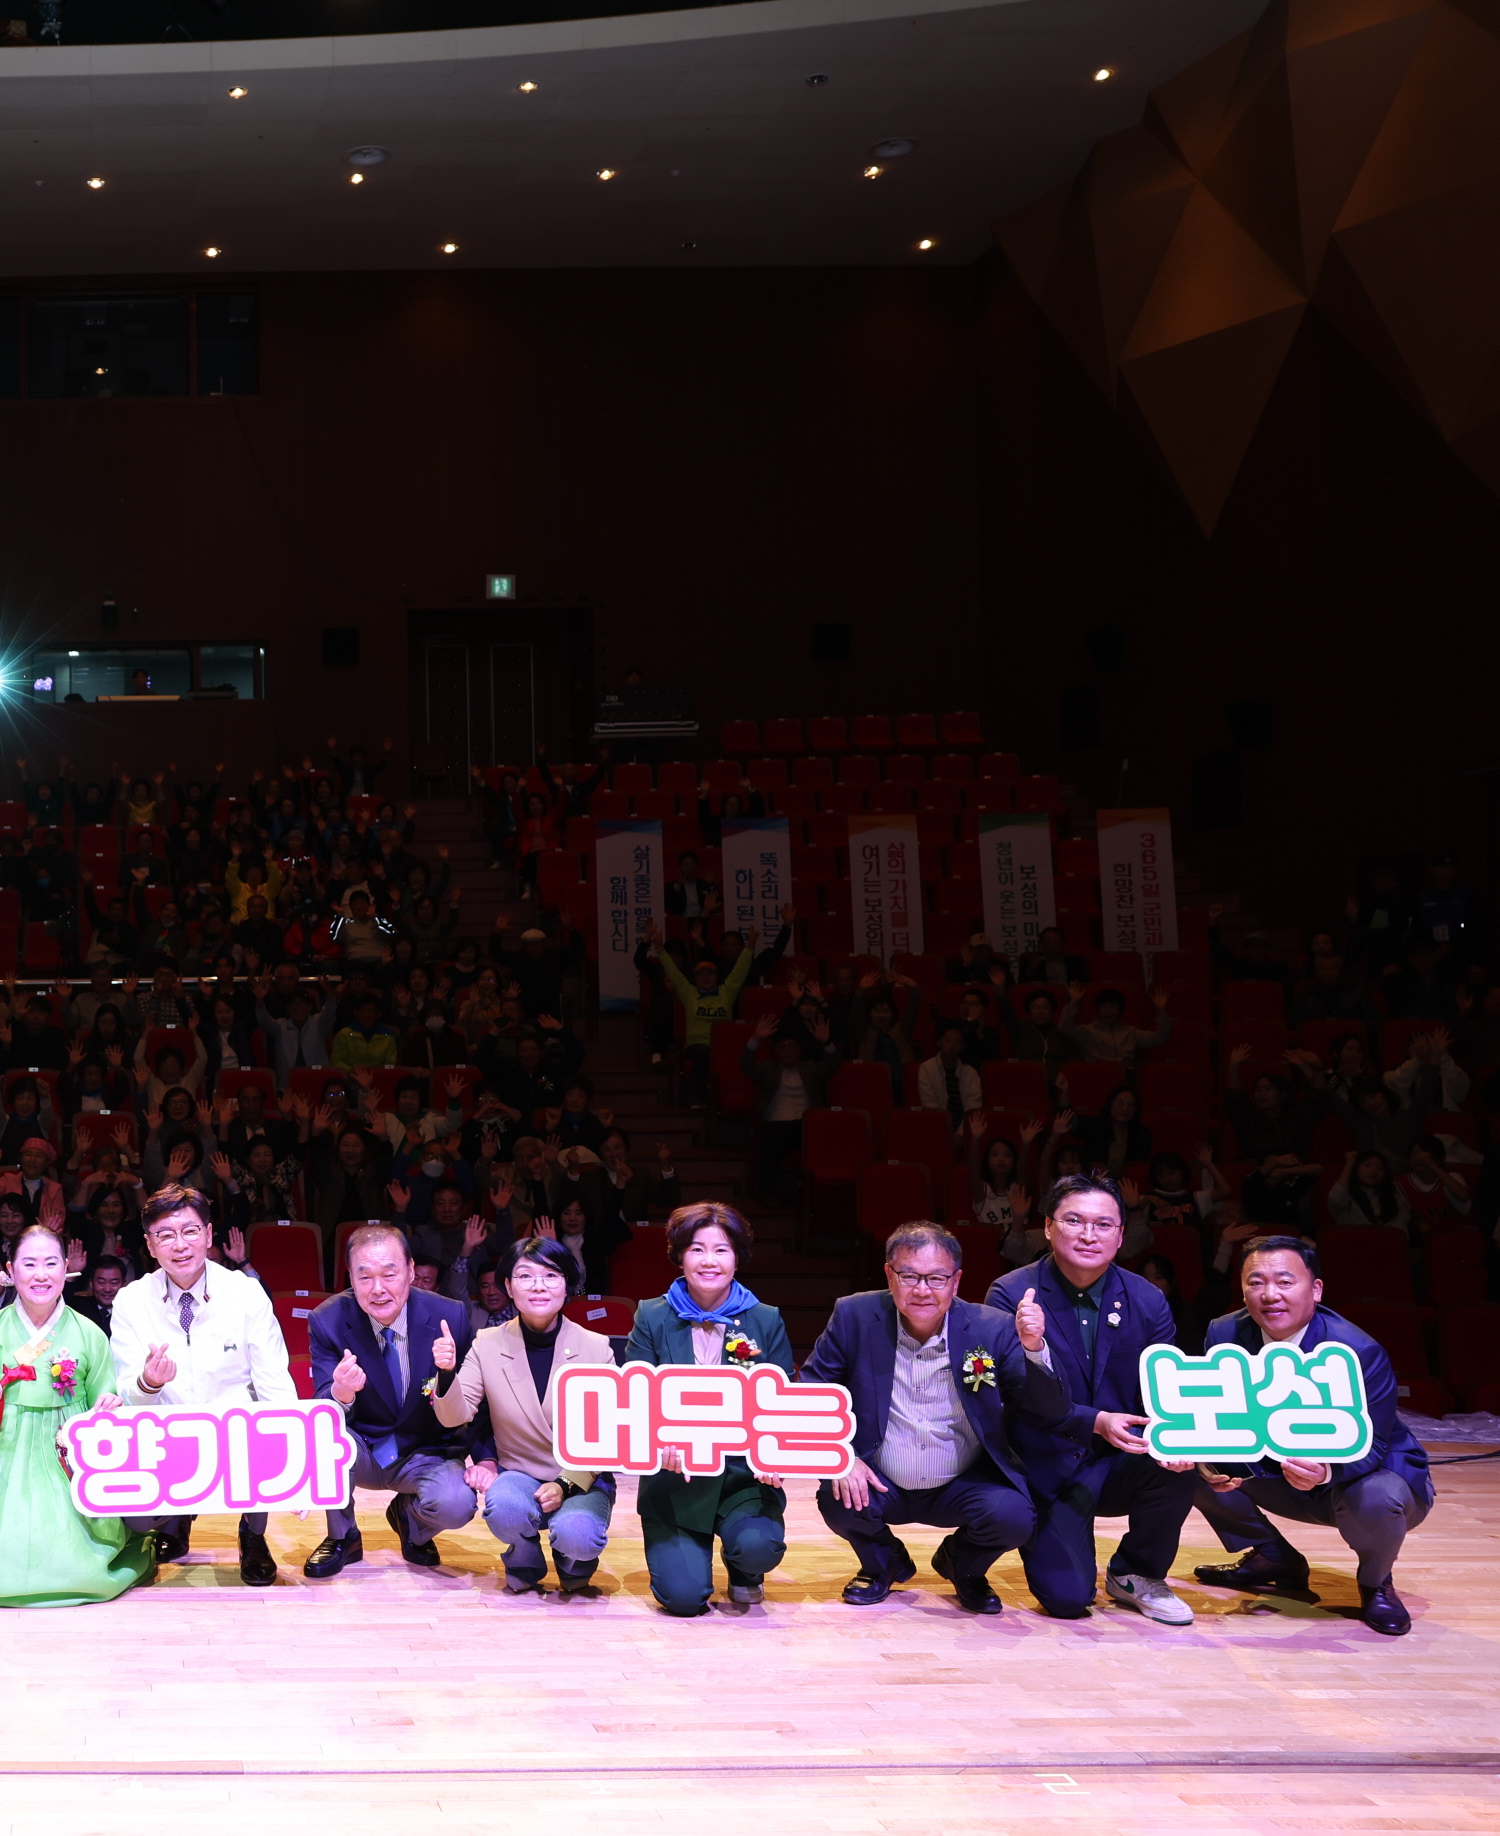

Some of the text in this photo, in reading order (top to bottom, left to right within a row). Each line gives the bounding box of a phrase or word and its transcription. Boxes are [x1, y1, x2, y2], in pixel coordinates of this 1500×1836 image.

[632, 845, 652, 904] 살기좋은
[759, 852, 779, 901] 똑소리
[862, 844, 882, 894] 여기는
[887, 842, 906, 875] 삶의
[996, 842, 1014, 886] 청년이
[1140, 833, 1160, 898] 365일
[735, 869, 755, 901] 하나
[889, 879, 909, 928] 가치를
[999, 890, 1017, 920] 웃는
[1020, 865, 1038, 916] 보성의
[1113, 863, 1135, 909] 희망찬
[610, 876, 629, 953] 함께 합시다
[736, 905, 755, 922] 된
[1142, 901, 1164, 947] 군민과
[563, 1371, 846, 1469] 머무는
[1152, 1351, 1362, 1451] 보성
[73, 1409, 347, 1508] 향기가
